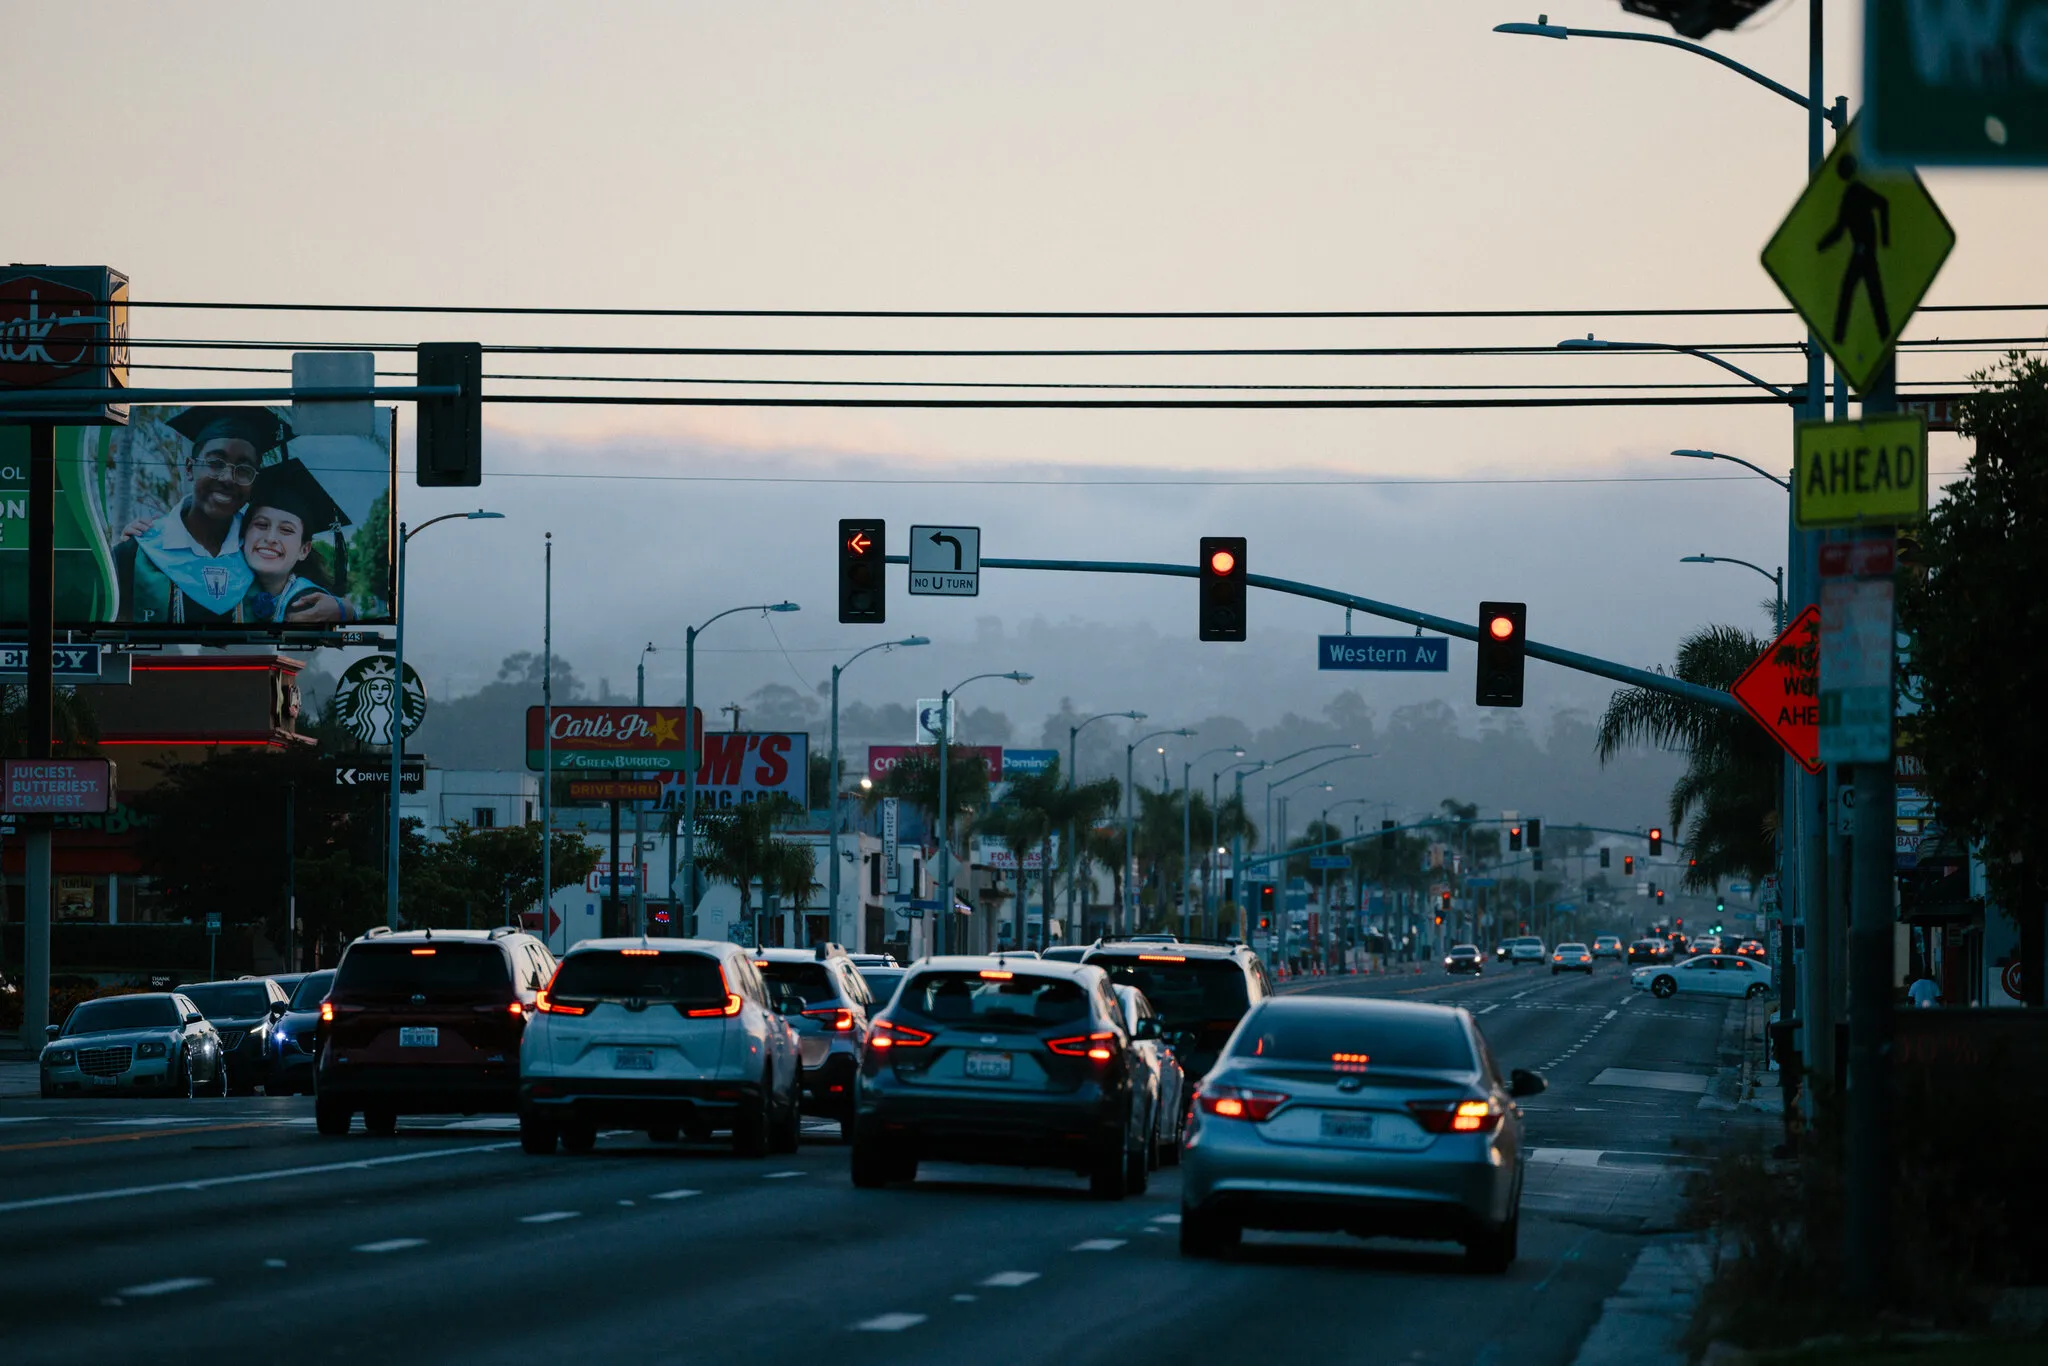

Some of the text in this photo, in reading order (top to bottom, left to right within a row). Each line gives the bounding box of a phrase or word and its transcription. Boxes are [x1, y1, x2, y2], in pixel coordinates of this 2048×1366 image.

[0, 466, 26, 480] OL
[1808, 446, 1914, 495] AHEAD
[914, 577, 973, 590] NO U TURN
[343, 632, 362, 642] 443
[1330, 645, 1437, 663] Western Av
[550, 713, 653, 740] Carl's Jr.
[12, 766, 77, 778] JUICIEST.
[358, 772, 420, 781] DRIVE HRU
[12, 781, 99, 792] BUTTERIEST.
[570, 784, 659, 796] DRIVE THRU
[12, 795, 84, 807] CRAVIEST.
